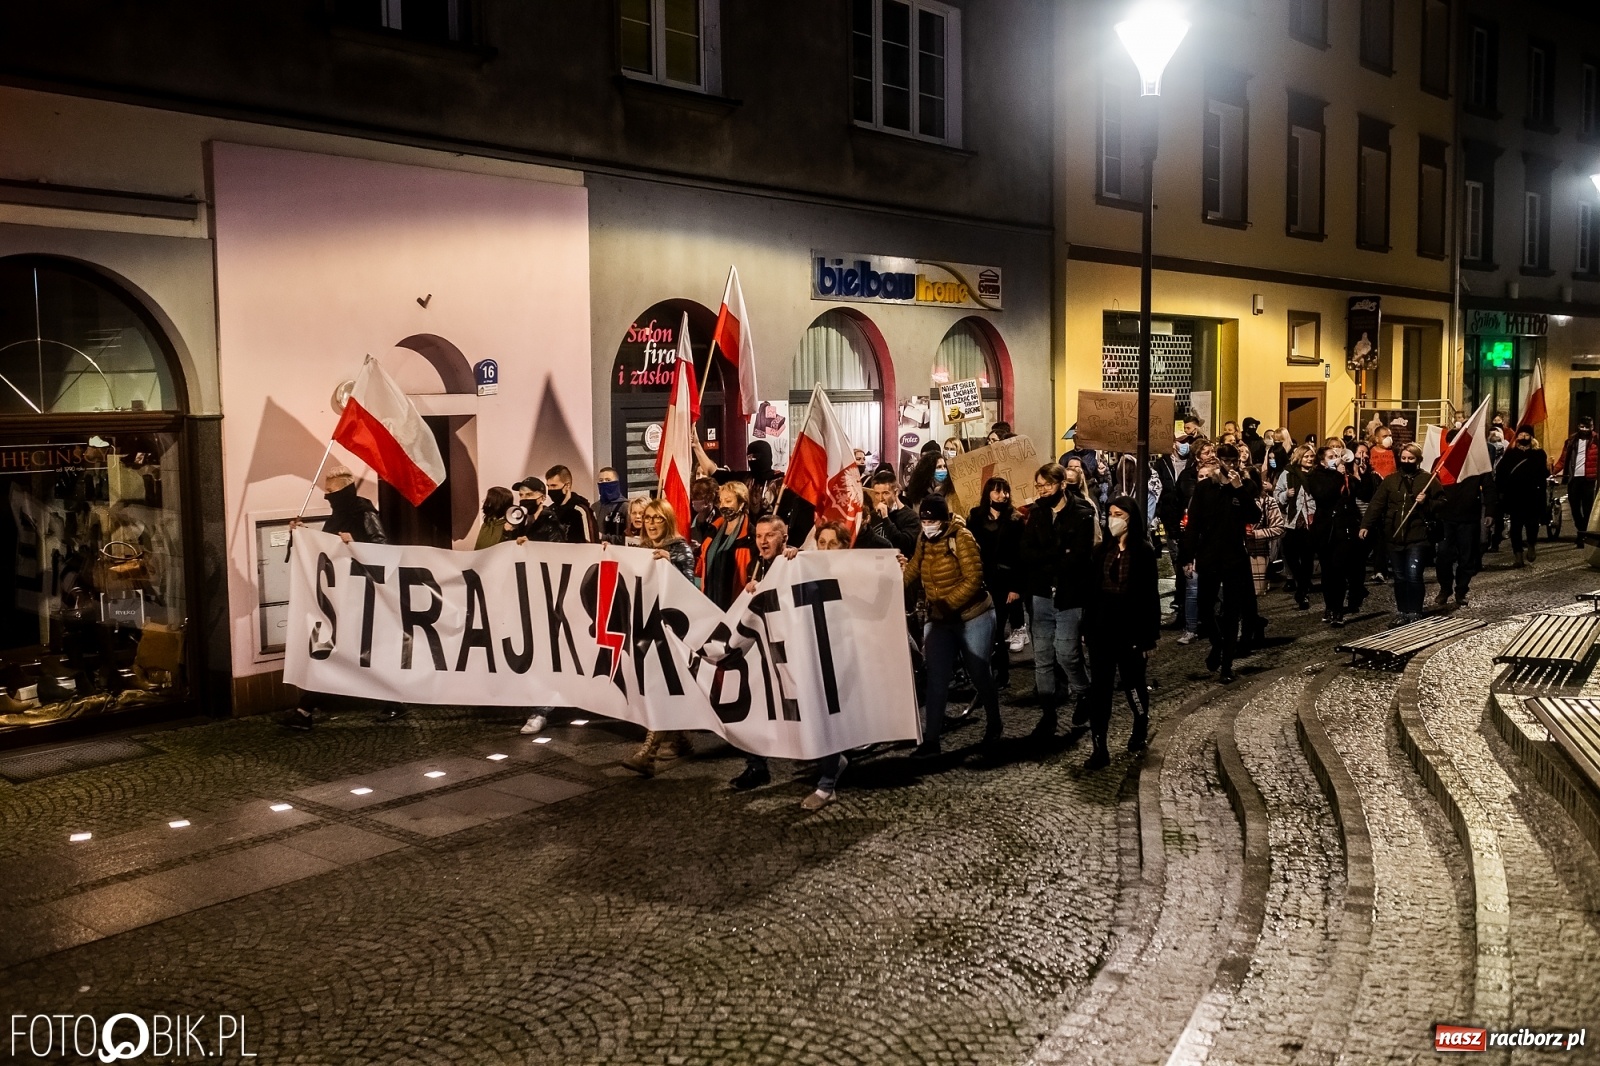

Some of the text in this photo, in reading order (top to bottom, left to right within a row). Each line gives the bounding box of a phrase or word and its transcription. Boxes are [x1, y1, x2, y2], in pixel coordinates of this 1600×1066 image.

[814, 257, 969, 303] bielbaw home
[627, 319, 673, 343] Salon
[1503, 311, 1548, 335] TATTOO
[482, 365, 495, 379] 16
[618, 365, 624, 385] i
[962, 467, 1013, 499] JET
[308, 551, 585, 676] STRAJK
